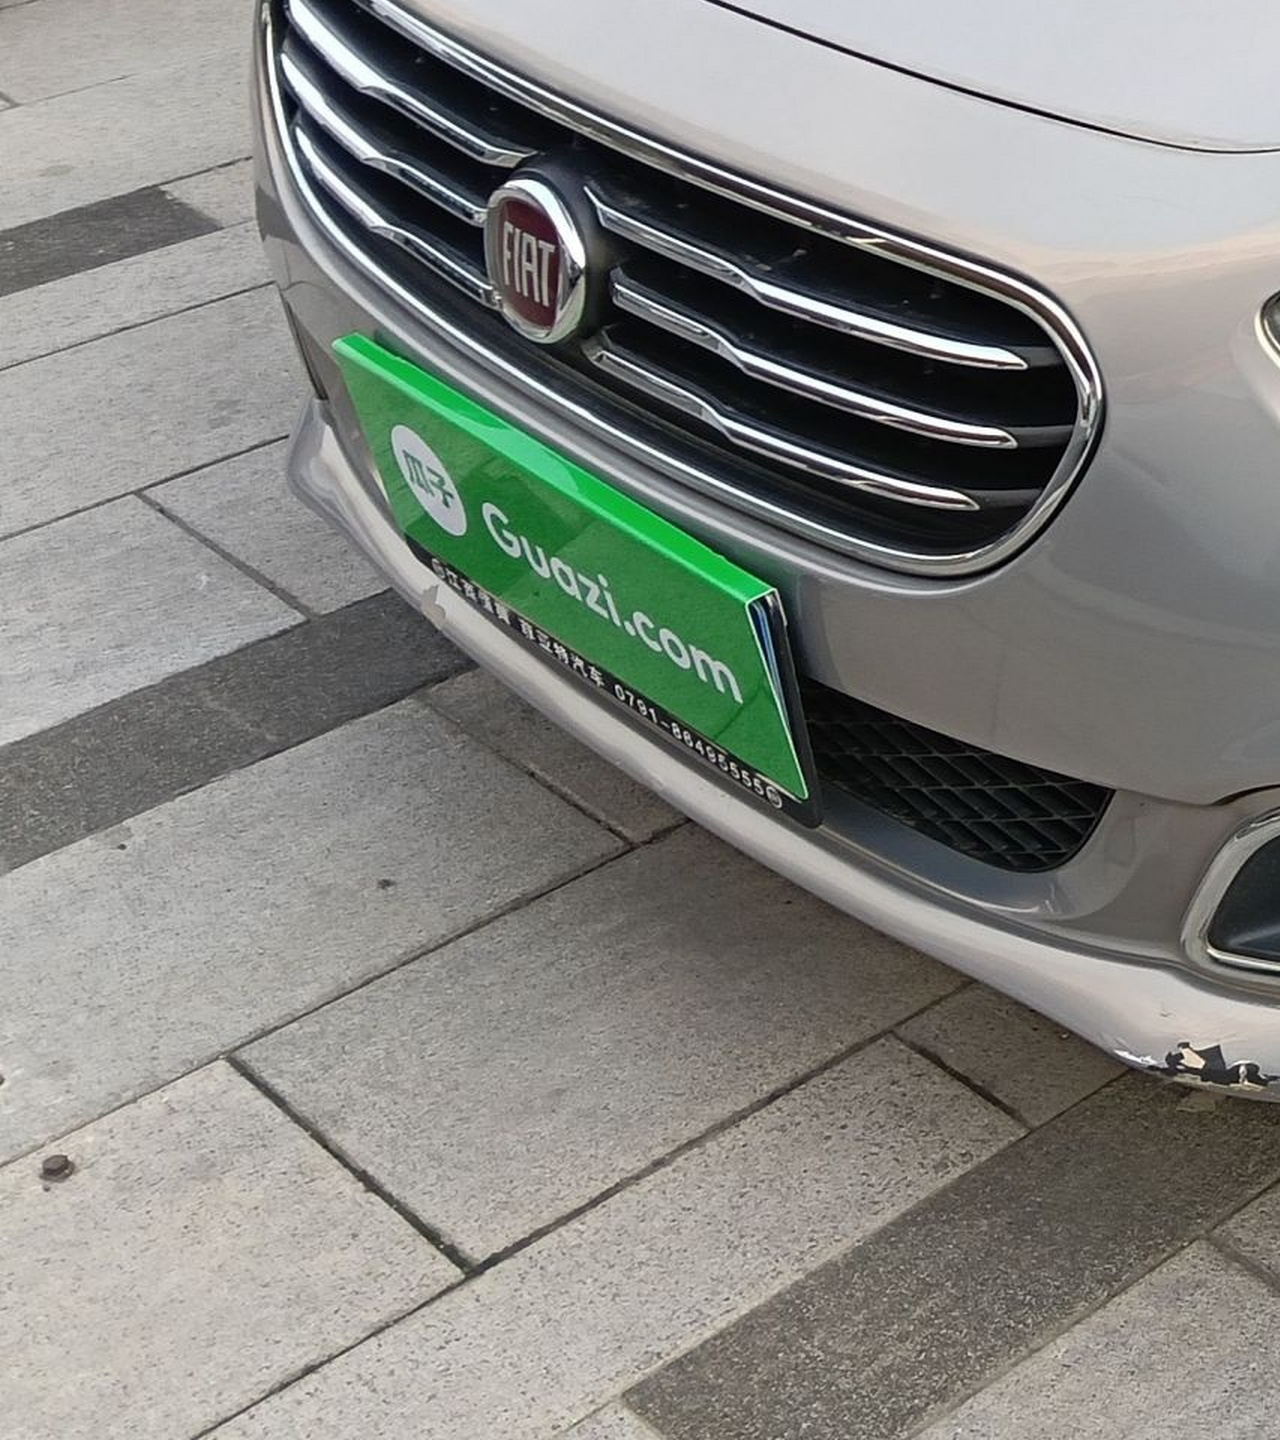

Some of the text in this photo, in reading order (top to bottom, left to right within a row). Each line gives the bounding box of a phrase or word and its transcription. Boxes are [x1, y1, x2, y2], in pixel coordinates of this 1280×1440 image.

[503, 220, 556, 307] FIAT
[402, 449, 455, 509] 瓜子
[482, 502, 744, 705] Guazi.com
